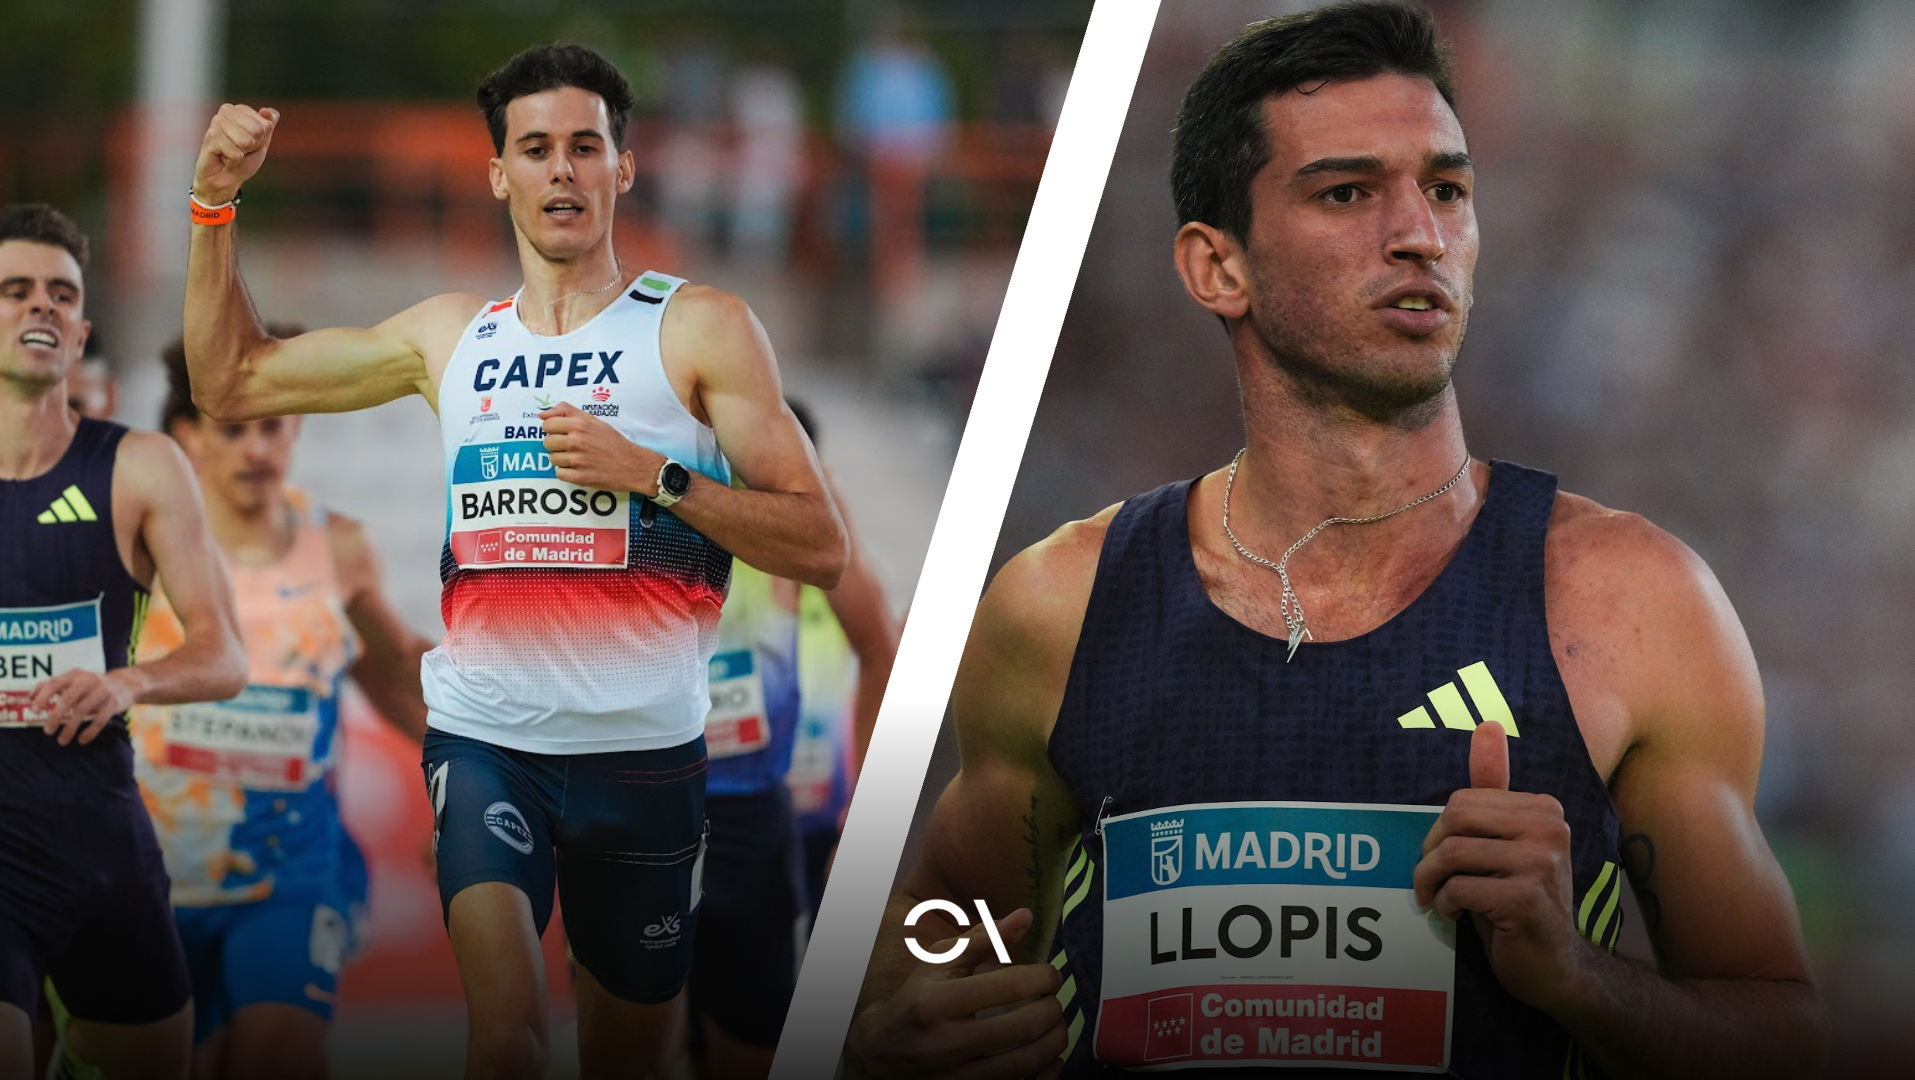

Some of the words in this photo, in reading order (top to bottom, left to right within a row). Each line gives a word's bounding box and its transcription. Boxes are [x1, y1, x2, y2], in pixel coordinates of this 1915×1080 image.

[473, 350, 624, 393] CAPEX
[502, 452, 552, 472] MAD
[461, 488, 617, 520] BARROSO
[504, 530, 594, 545] Comunidad
[504, 547, 526, 561] de
[532, 547, 594, 562] Madrid
[1194, 831, 1381, 880] MADRID
[1150, 904, 1383, 966] LLOPIS
[1200, 993, 1384, 1021] Comunidad
[1200, 1028, 1245, 1055] de
[1258, 1027, 1382, 1058] Madrid
